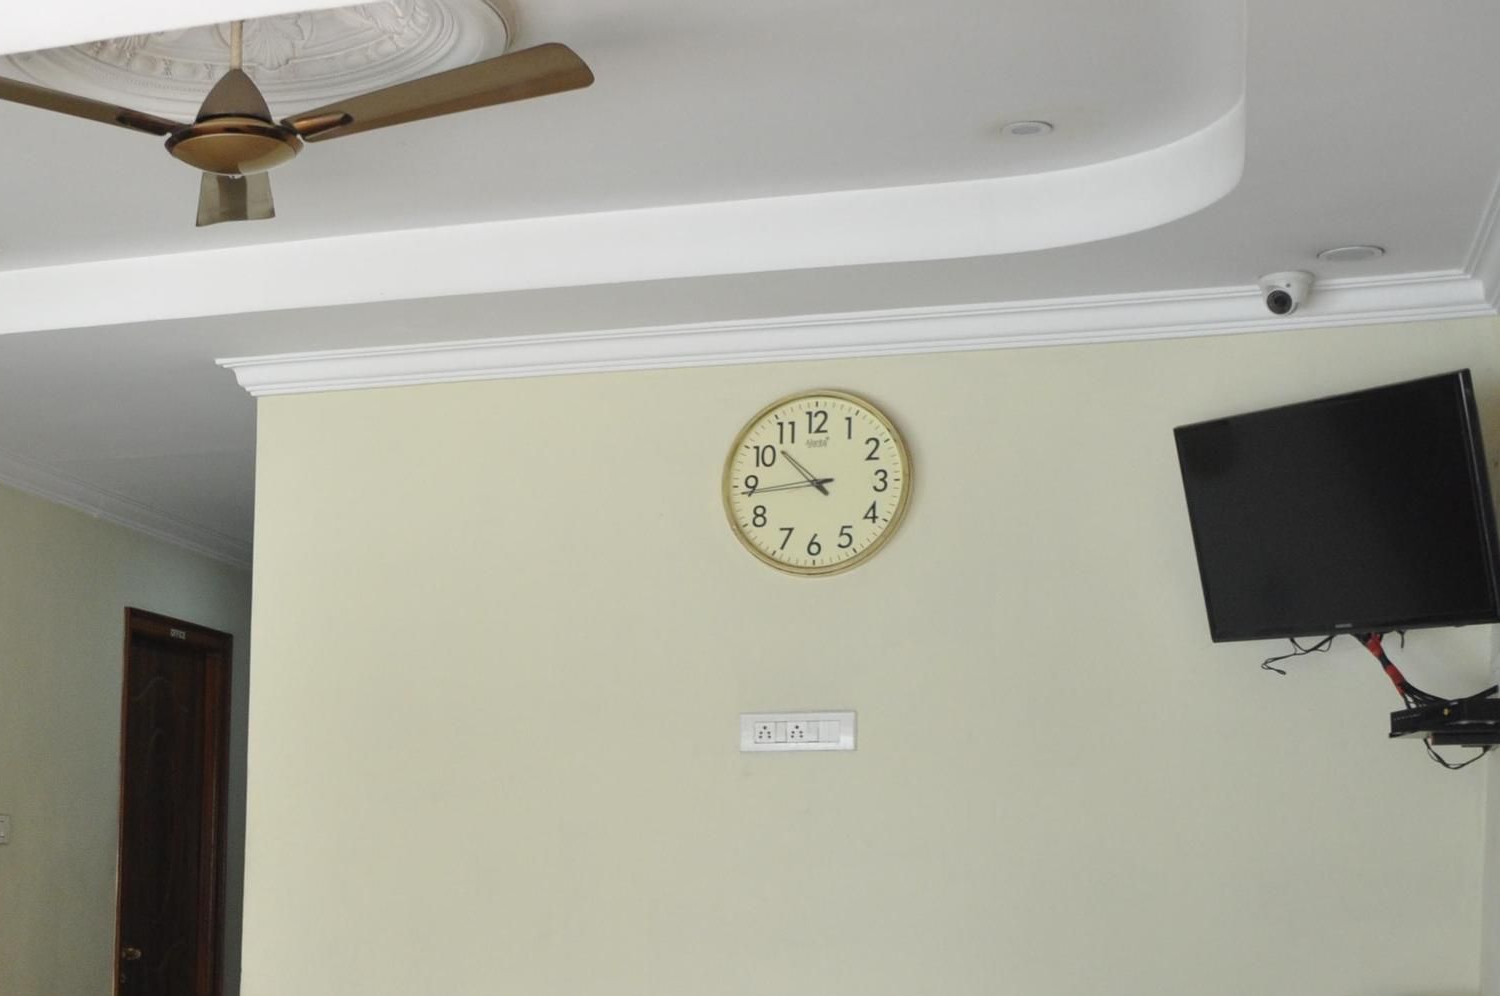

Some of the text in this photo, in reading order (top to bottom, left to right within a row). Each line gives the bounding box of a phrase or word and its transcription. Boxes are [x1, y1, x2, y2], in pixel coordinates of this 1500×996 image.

[776, 421, 796, 445] 11
[805, 410, 829, 434] 12
[845, 416, 853, 440] 1
[753, 444, 777, 468] 10
[864, 437, 881, 461] 2
[744, 475, 760, 498] 9
[872, 469, 889, 493] 3
[752, 504, 768, 528] 8
[862, 500, 879, 524] 4
[779, 527, 795, 551] 7
[806, 533, 822, 557] 6
[837, 525, 854, 549] 5
